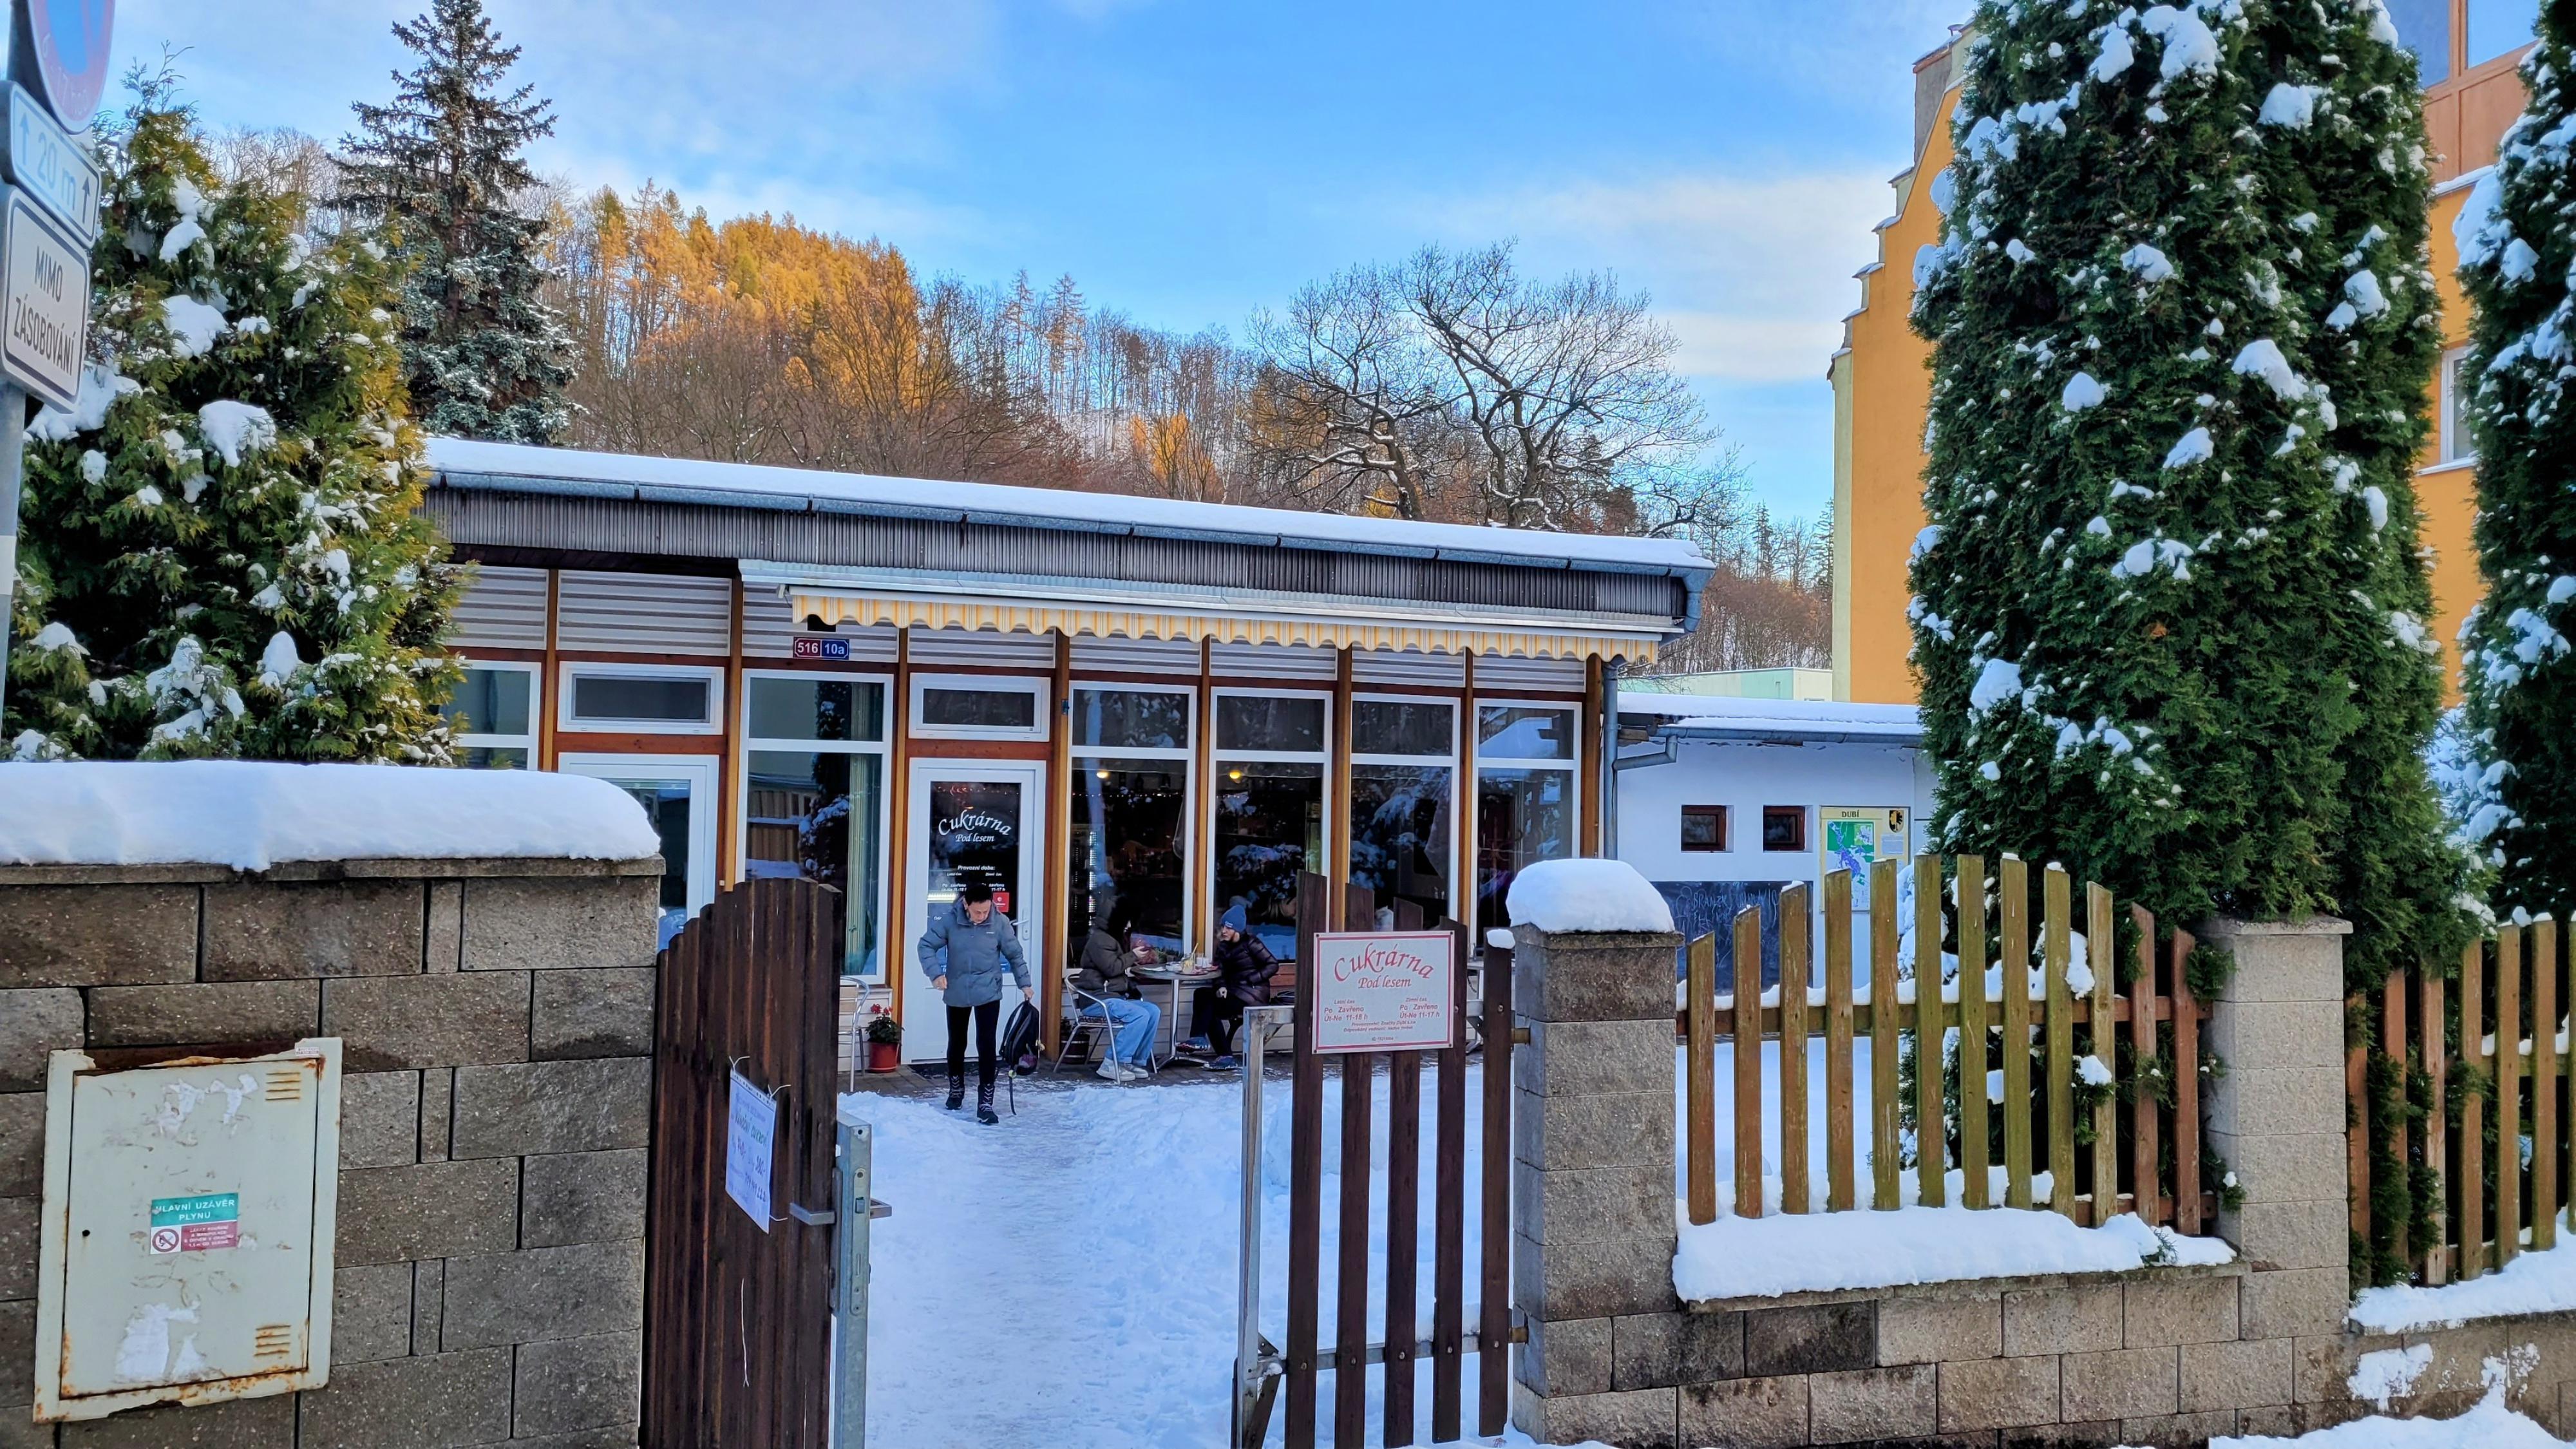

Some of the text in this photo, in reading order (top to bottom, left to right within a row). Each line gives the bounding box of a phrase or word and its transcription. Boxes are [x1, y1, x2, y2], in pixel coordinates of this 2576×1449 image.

[37, 133, 77, 211] 20 m
[34, 245, 64, 303] MIMO
[14, 294, 77, 376] ZÁSOBOVÁNÍ
[797, 642, 819, 654] 516
[824, 643, 845, 655] 10a
[1841, 810, 1860, 818] DUBÍ
[938, 809, 1012, 836] Cukrárna
[955, 833, 994, 842] Pod lesem
[1334, 942, 1434, 982] Cukrárna
[1358, 974, 1412, 989] Pod lesem
[196, 1199, 235, 1209] UZÁVĚR
[179, 1211, 211, 1221] PLYNU
